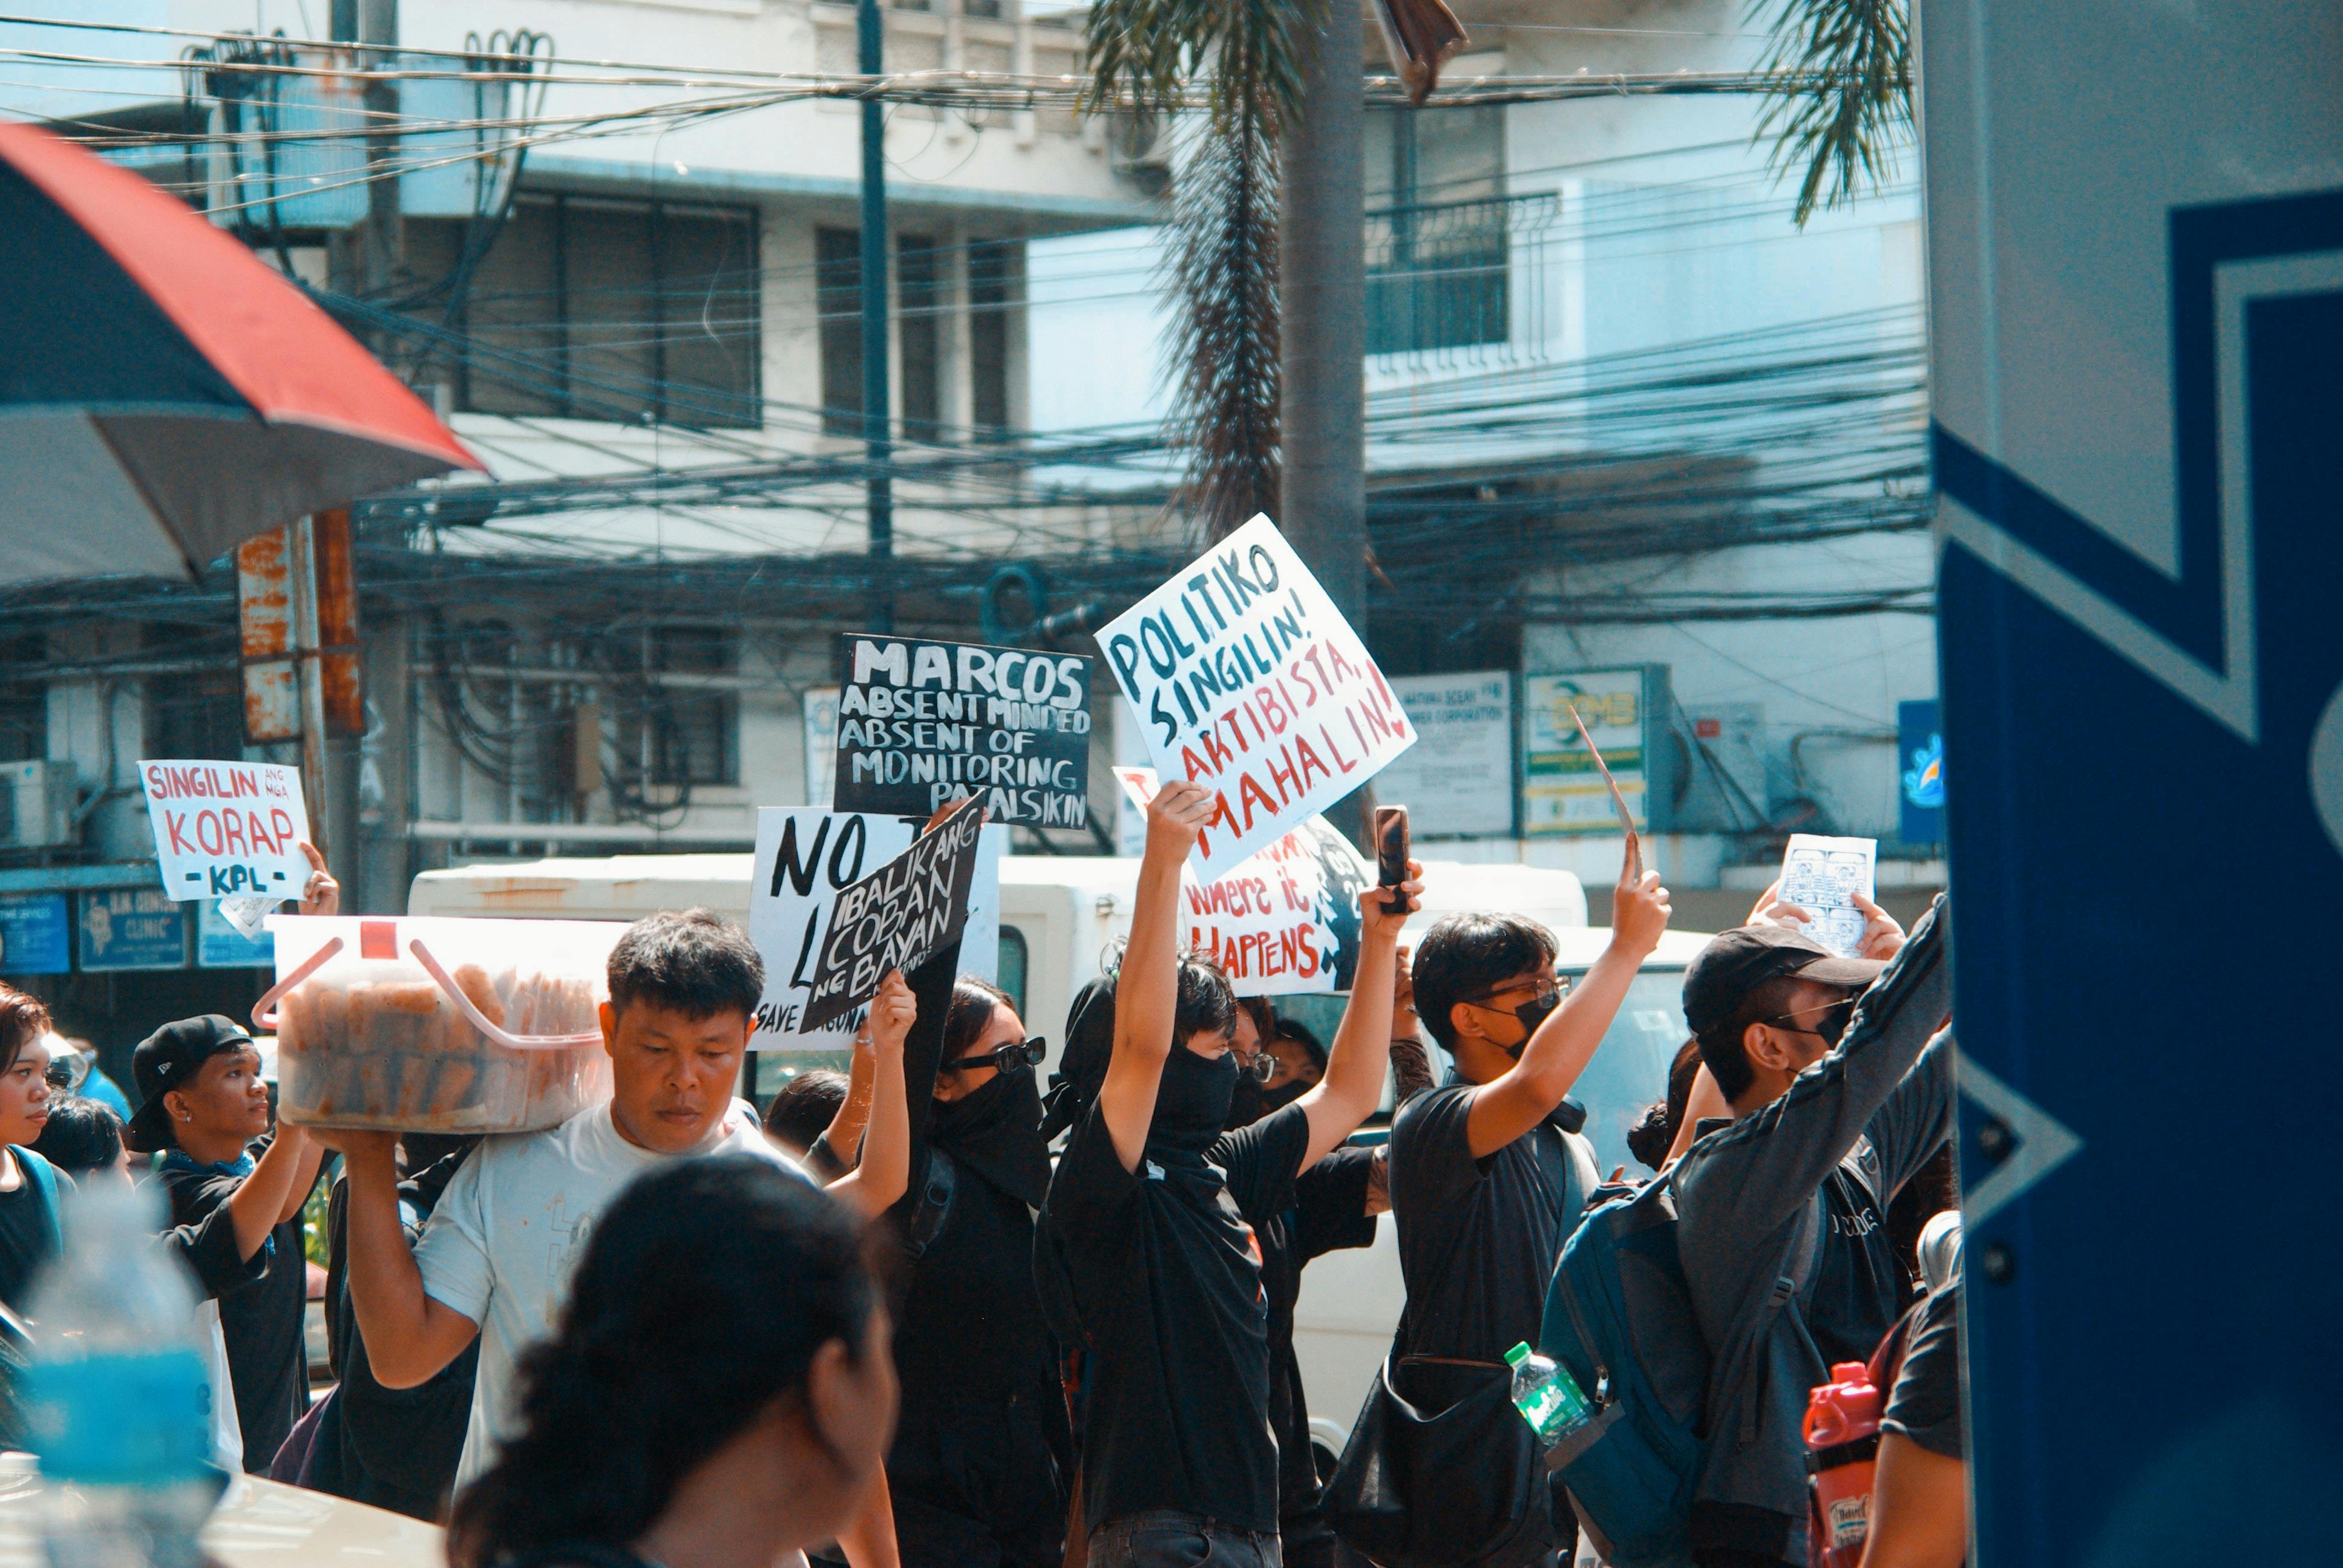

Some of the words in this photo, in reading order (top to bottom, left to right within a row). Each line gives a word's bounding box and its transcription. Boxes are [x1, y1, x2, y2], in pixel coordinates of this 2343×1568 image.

[1109, 544, 1279, 704] POLITIKO
[852, 639, 1084, 710] MARCOS
[1151, 587, 1313, 748] SINGILIN!
[840, 684, 985, 722] ABSENT
[987, 696, 1091, 734] MINDED
[1182, 639, 1363, 782] AKTIBISTA,
[839, 719, 983, 754] ABSENT
[988, 730, 1037, 754] OF
[147, 765, 260, 800] SINGILIN
[264, 768, 284, 781] ANG
[265, 785, 290, 800] MGA
[165, 808, 294, 858] KORAP
[770, 814, 866, 897] NO
[833, 838, 927, 932] IBALIK
[929, 808, 978, 871] ANG
[1326, 850, 1355, 875] 09
[1277, 866, 1310, 912] it
[812, 969, 847, 1003] NG
[848, 898, 952, 998] BAYAN
[756, 1002, 799, 1033] SAVE
[813, 1007, 866, 1035] GUNA
